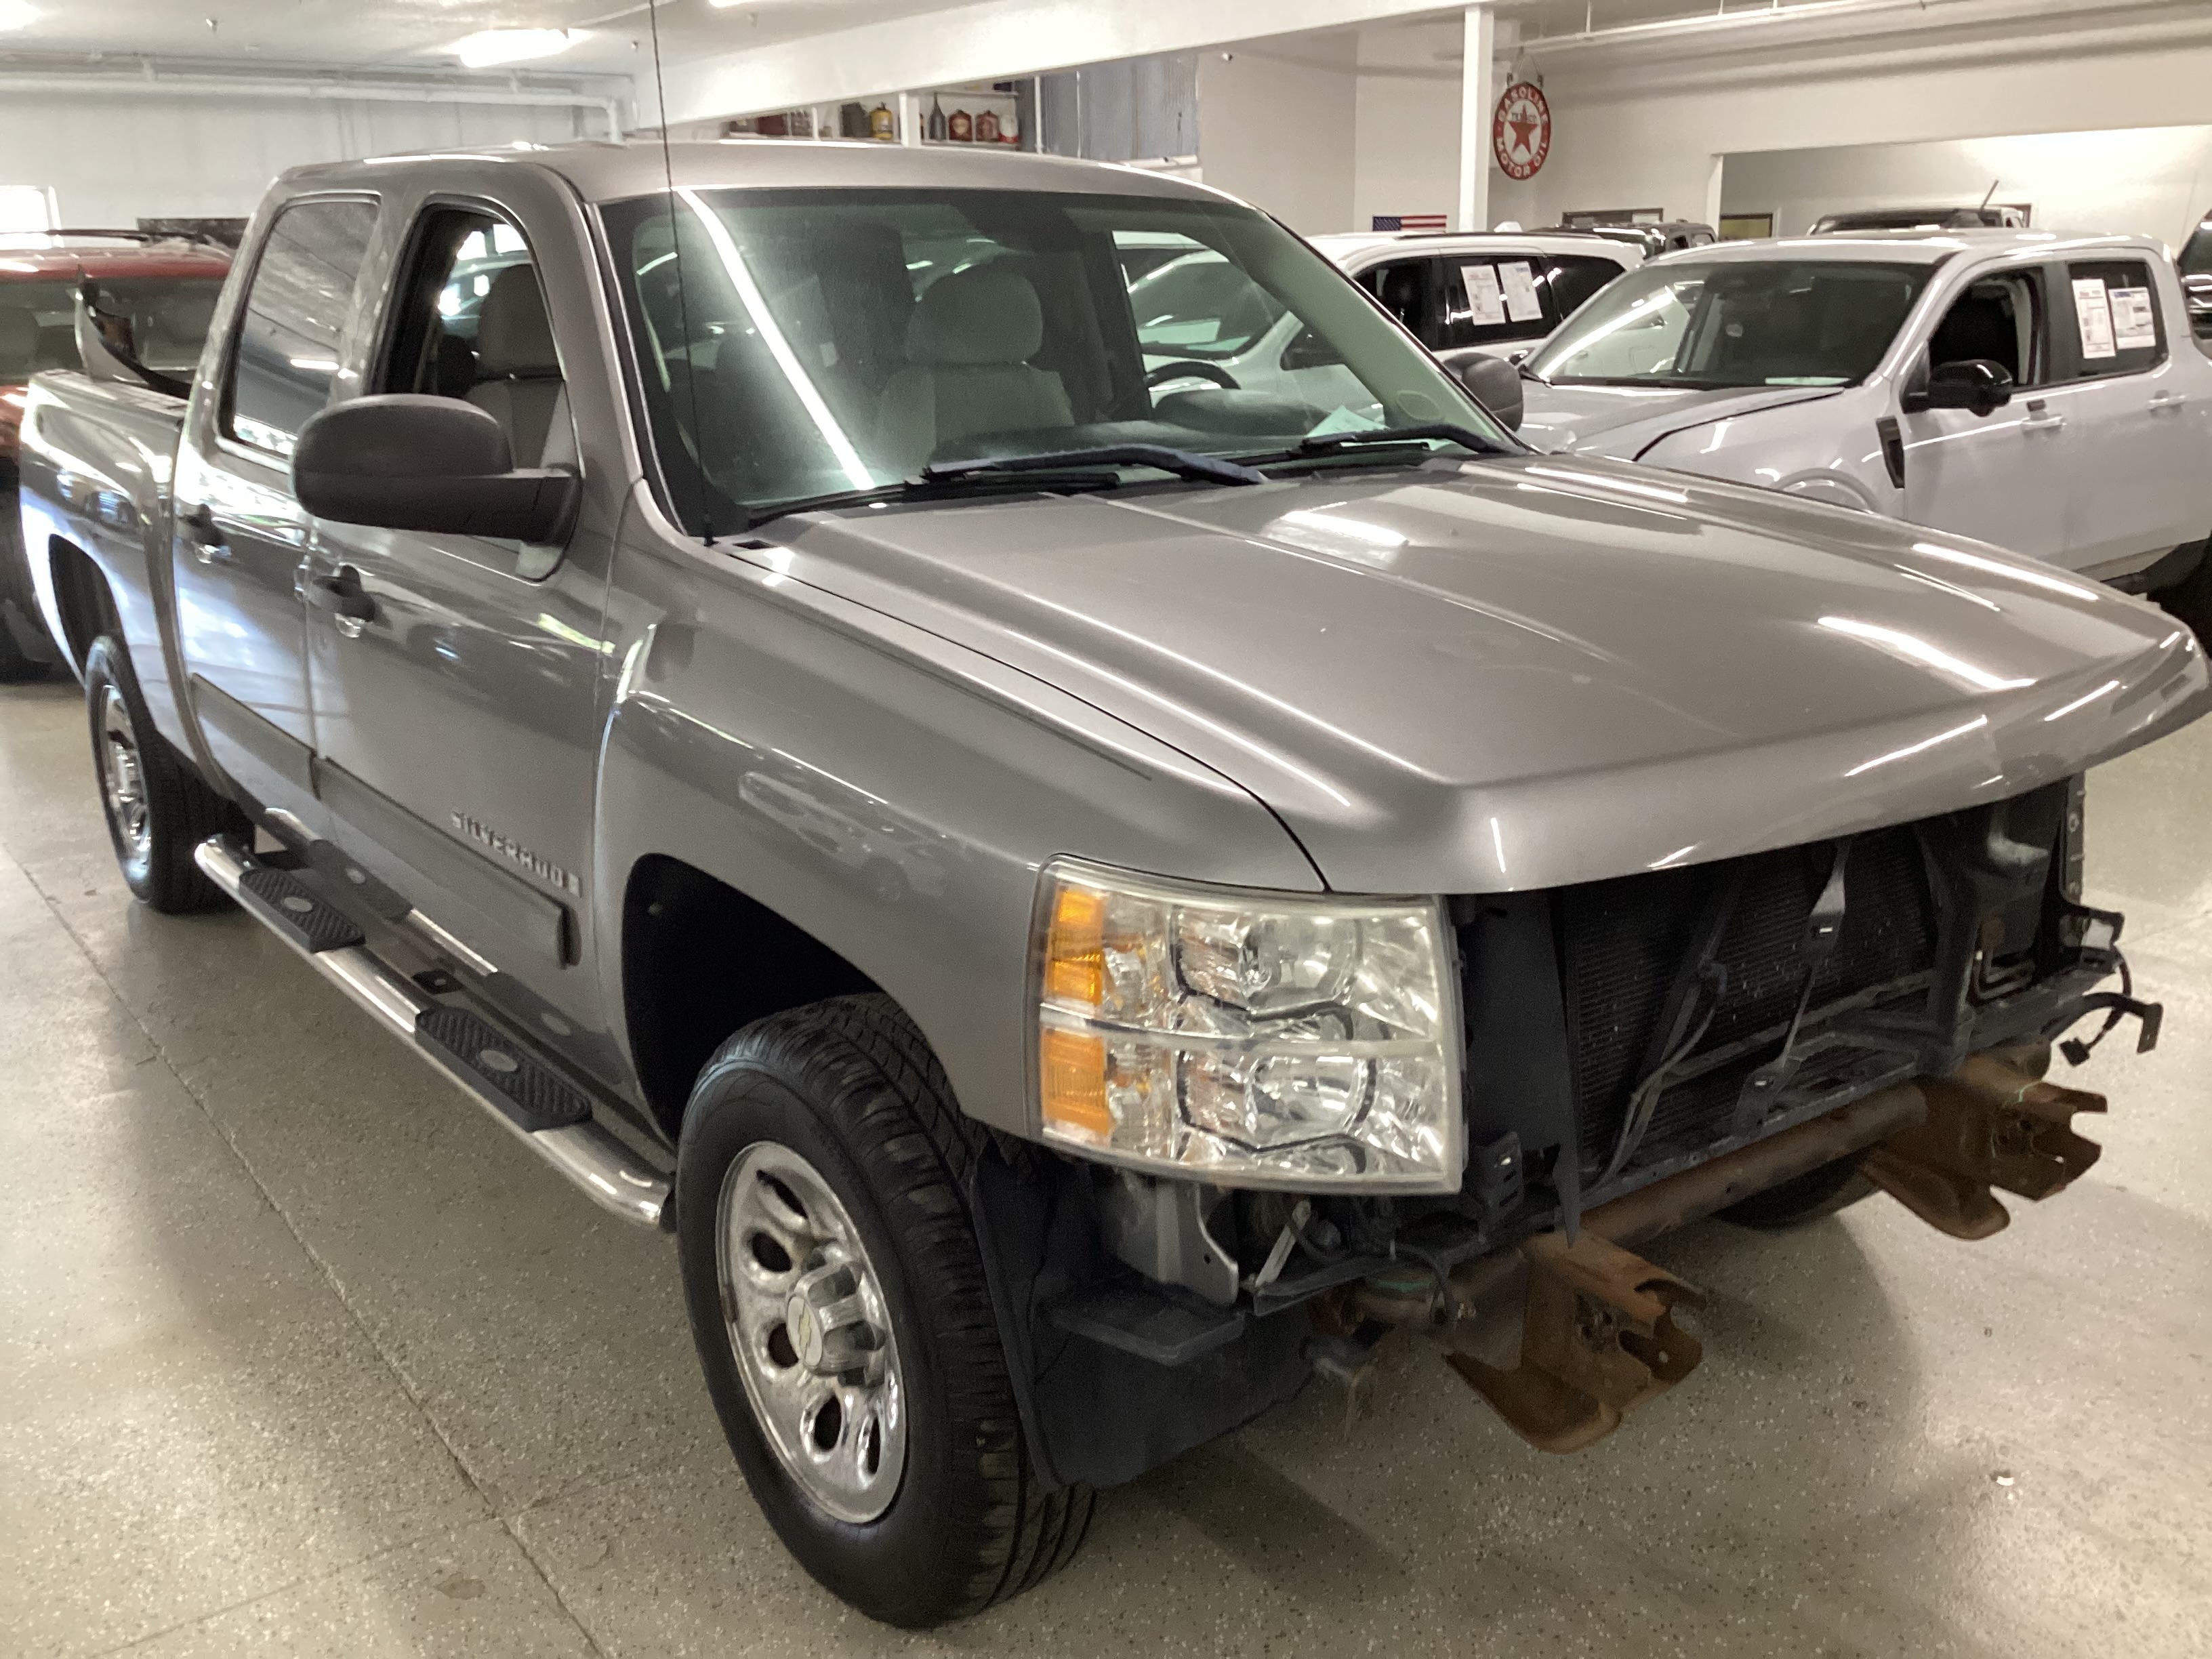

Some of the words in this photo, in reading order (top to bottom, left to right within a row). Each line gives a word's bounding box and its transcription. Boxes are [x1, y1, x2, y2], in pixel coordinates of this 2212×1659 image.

[1498, 86, 1549, 123] GASOLINE
[1496, 136, 1530, 178] MOTOR
[1533, 142, 1547, 167] OIL
[451, 811, 564, 888] SILVERADO
